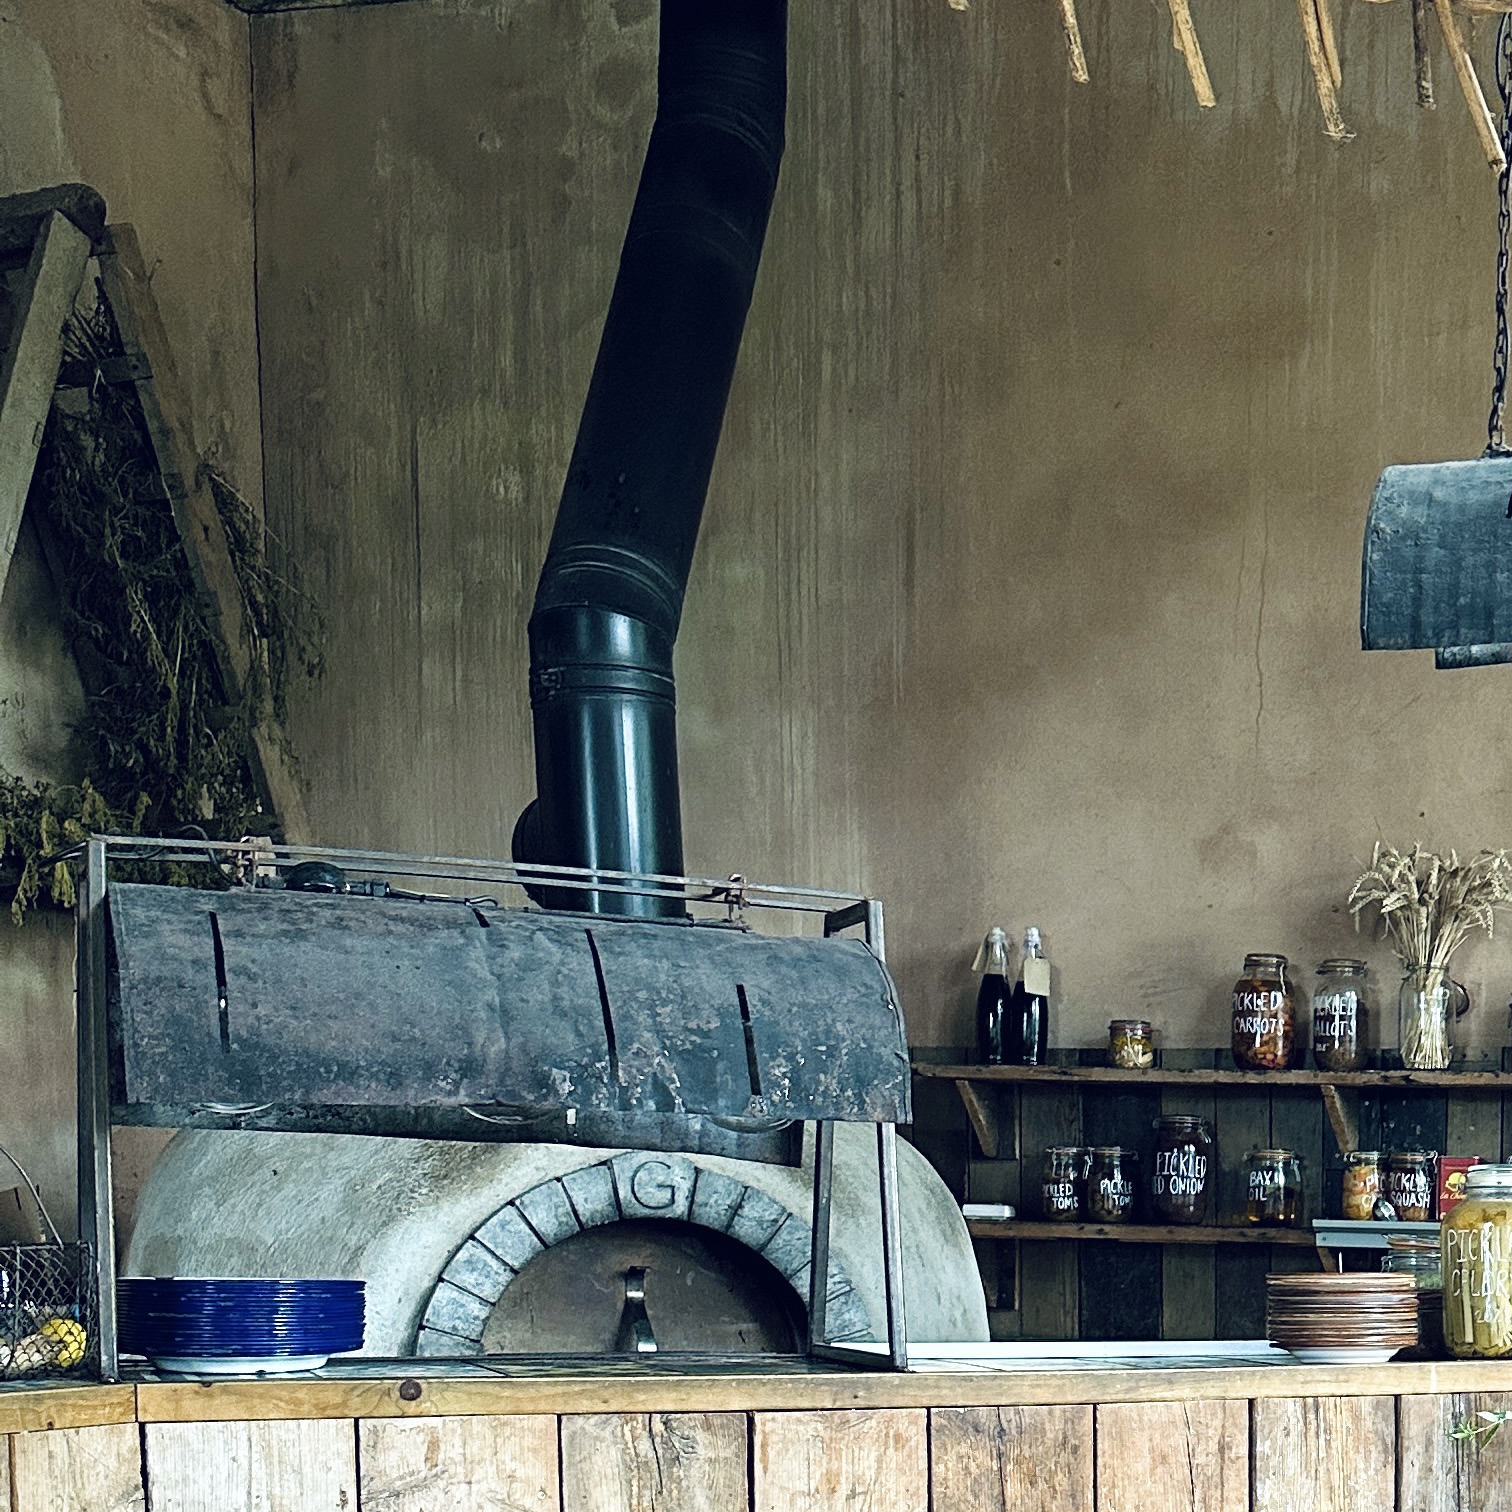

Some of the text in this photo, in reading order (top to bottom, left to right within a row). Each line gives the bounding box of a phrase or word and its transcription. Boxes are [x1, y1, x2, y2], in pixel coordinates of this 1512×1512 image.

[1233, 1017, 1285, 1037] CARROTS
[1156, 1150, 1208, 1178] PICKLED
[630, 1160, 676, 1210] G
[1248, 1186, 1268, 1202] OIL
[1052, 1196, 1079, 1210] TOMS
[1391, 1191, 1431, 1209] SQUASH
